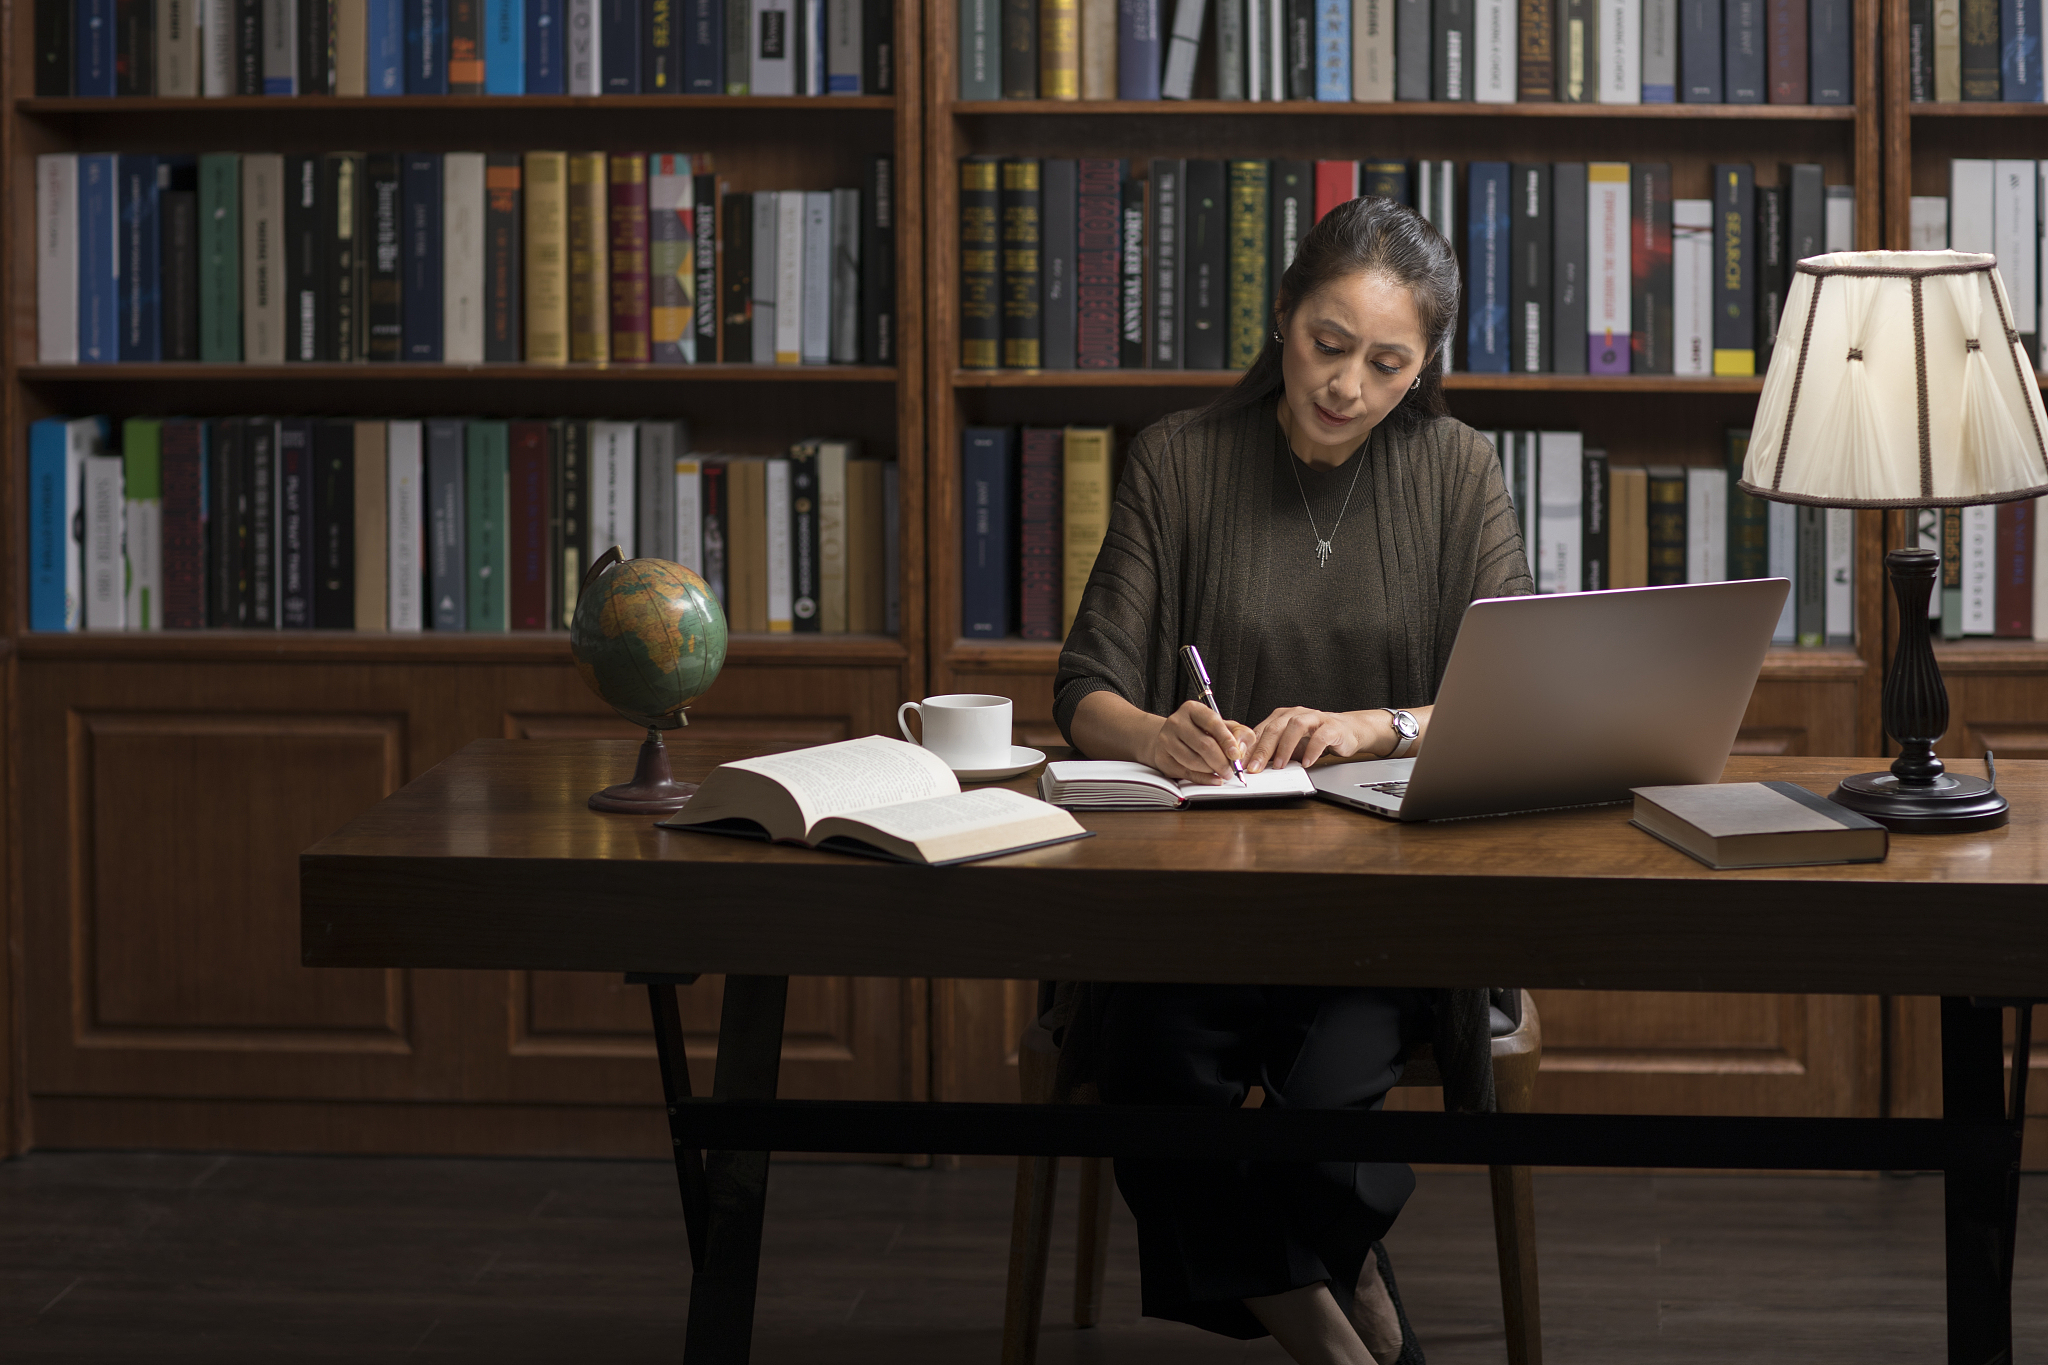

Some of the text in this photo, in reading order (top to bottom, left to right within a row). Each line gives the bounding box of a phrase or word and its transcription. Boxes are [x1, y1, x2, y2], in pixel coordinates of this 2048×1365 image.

[1123, 208, 1143, 343] ANNUAL REPORT
[1724, 211, 1741, 290] SEARCH
